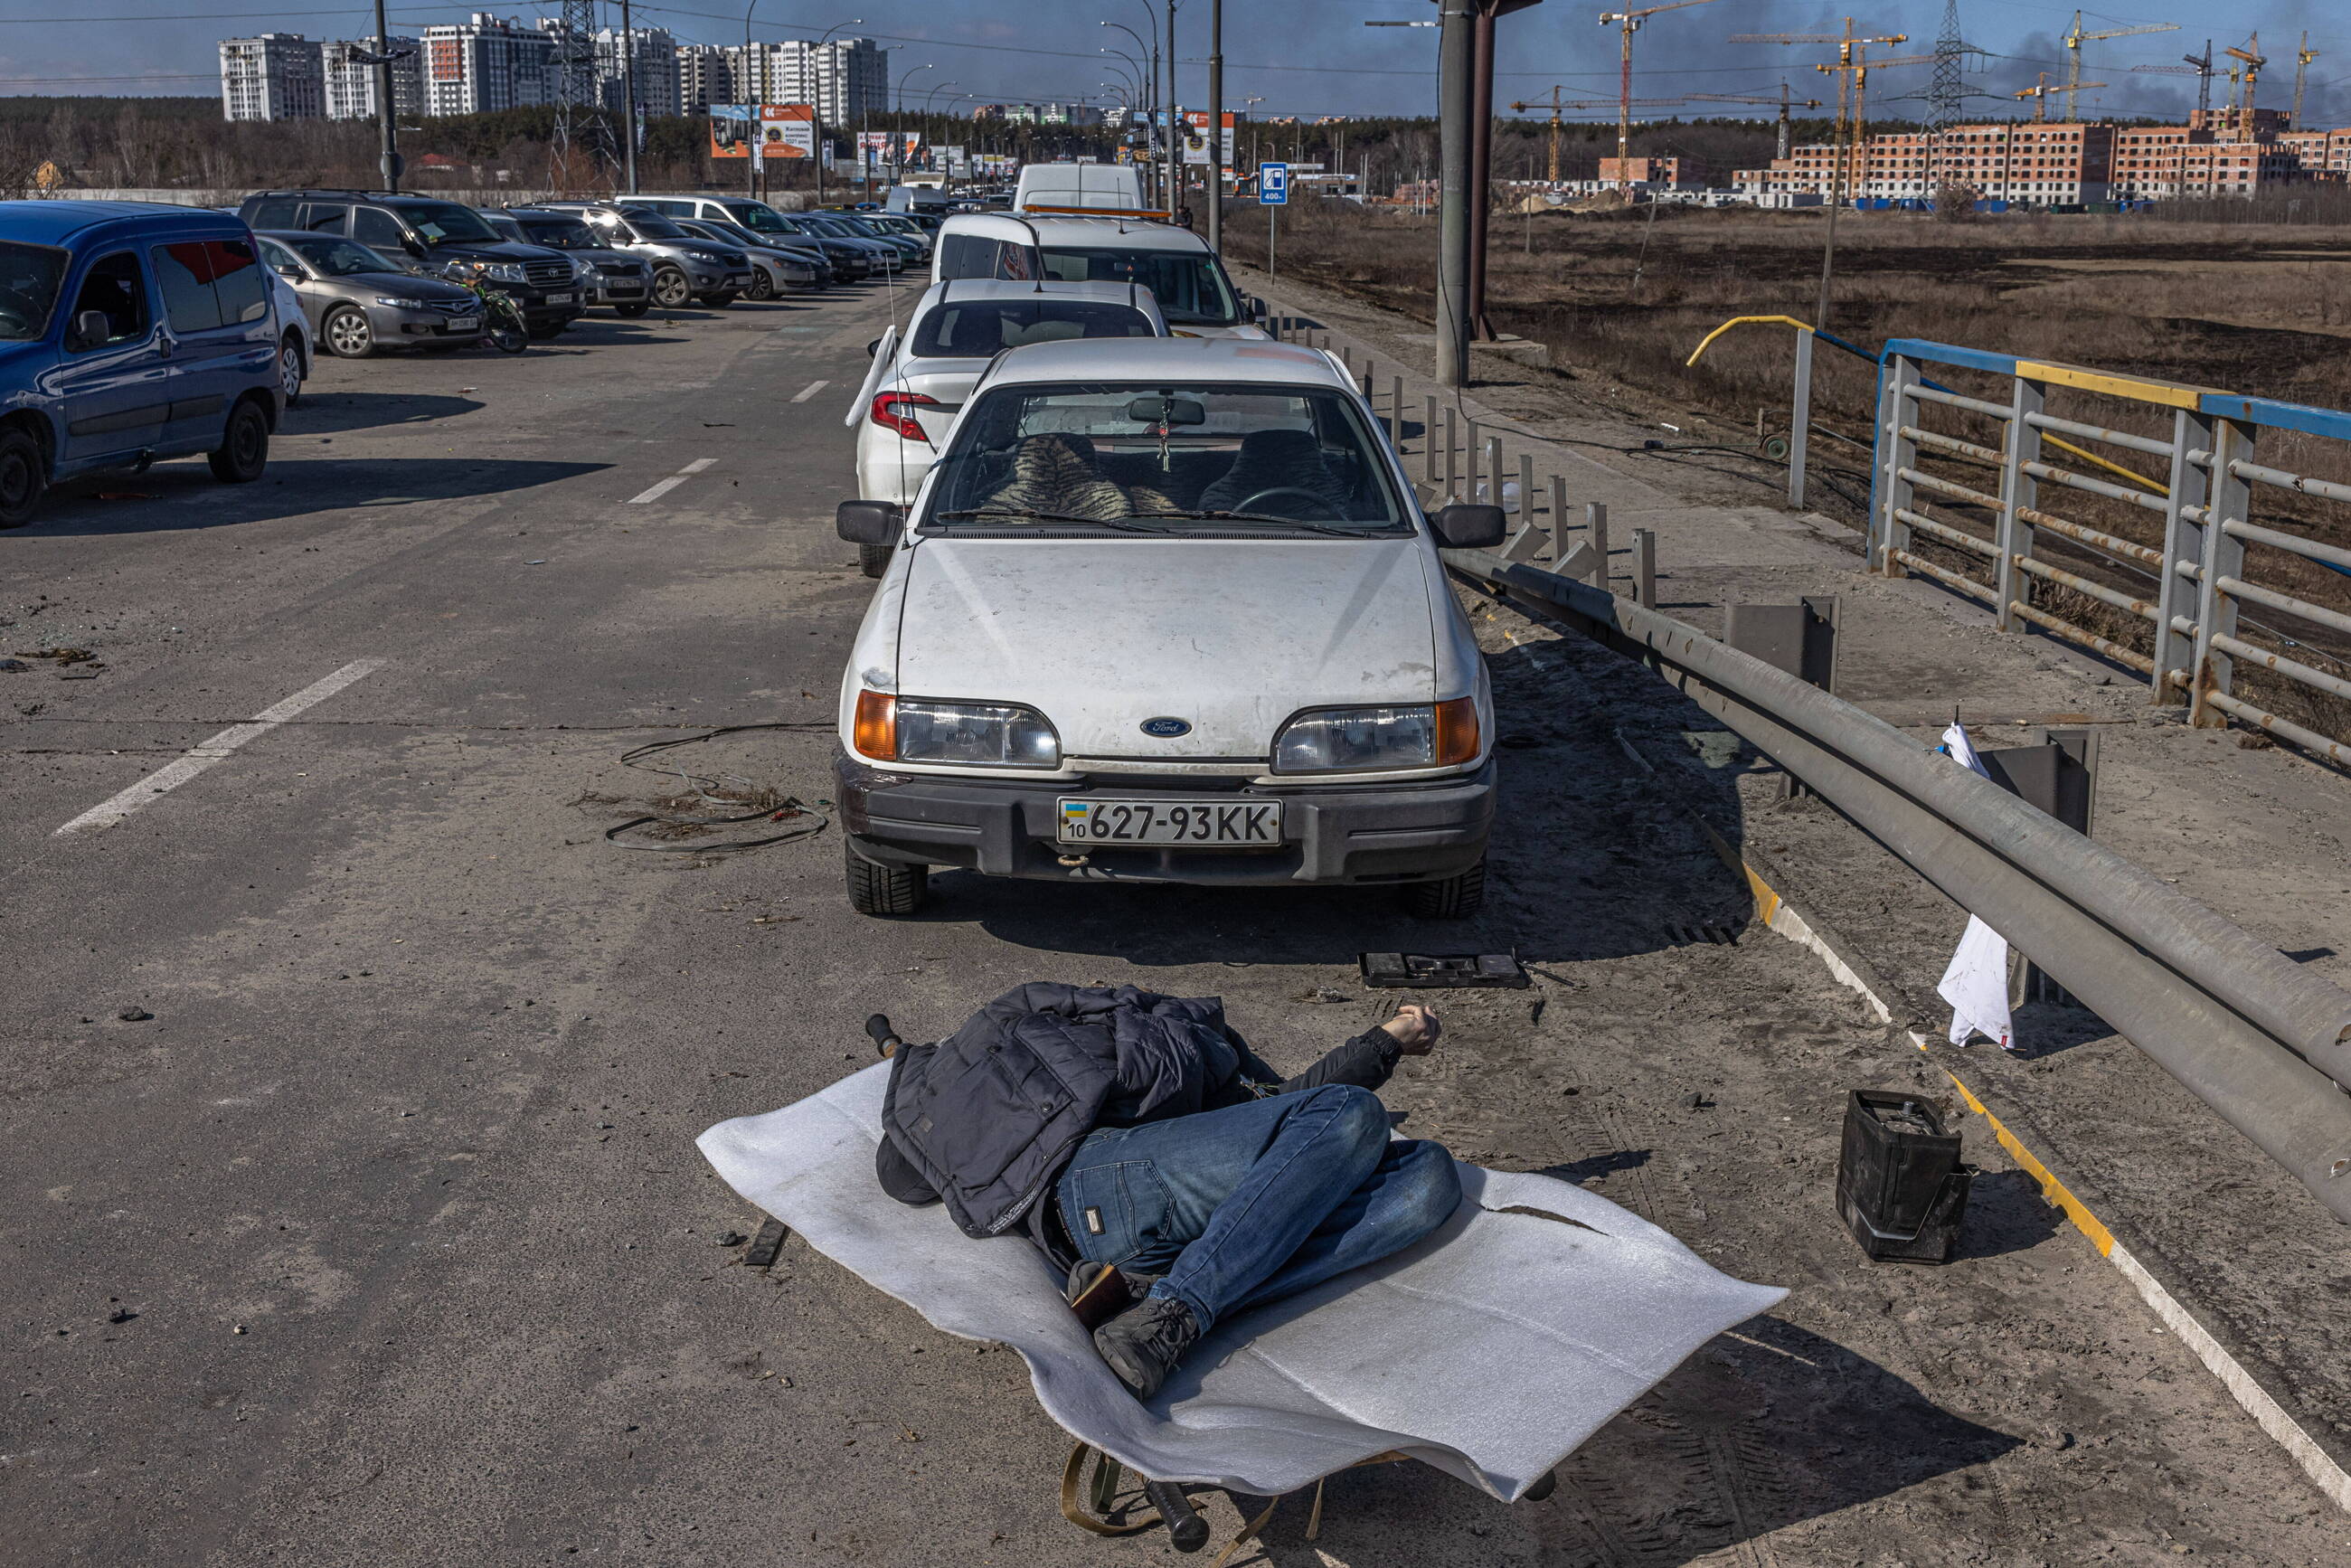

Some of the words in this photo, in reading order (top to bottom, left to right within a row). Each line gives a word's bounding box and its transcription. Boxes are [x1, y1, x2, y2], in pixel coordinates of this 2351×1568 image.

[1153, 721, 1179, 731] Ford
[1068, 824, 1086, 838] 10
[1091, 805, 1270, 841] 627-93KK
